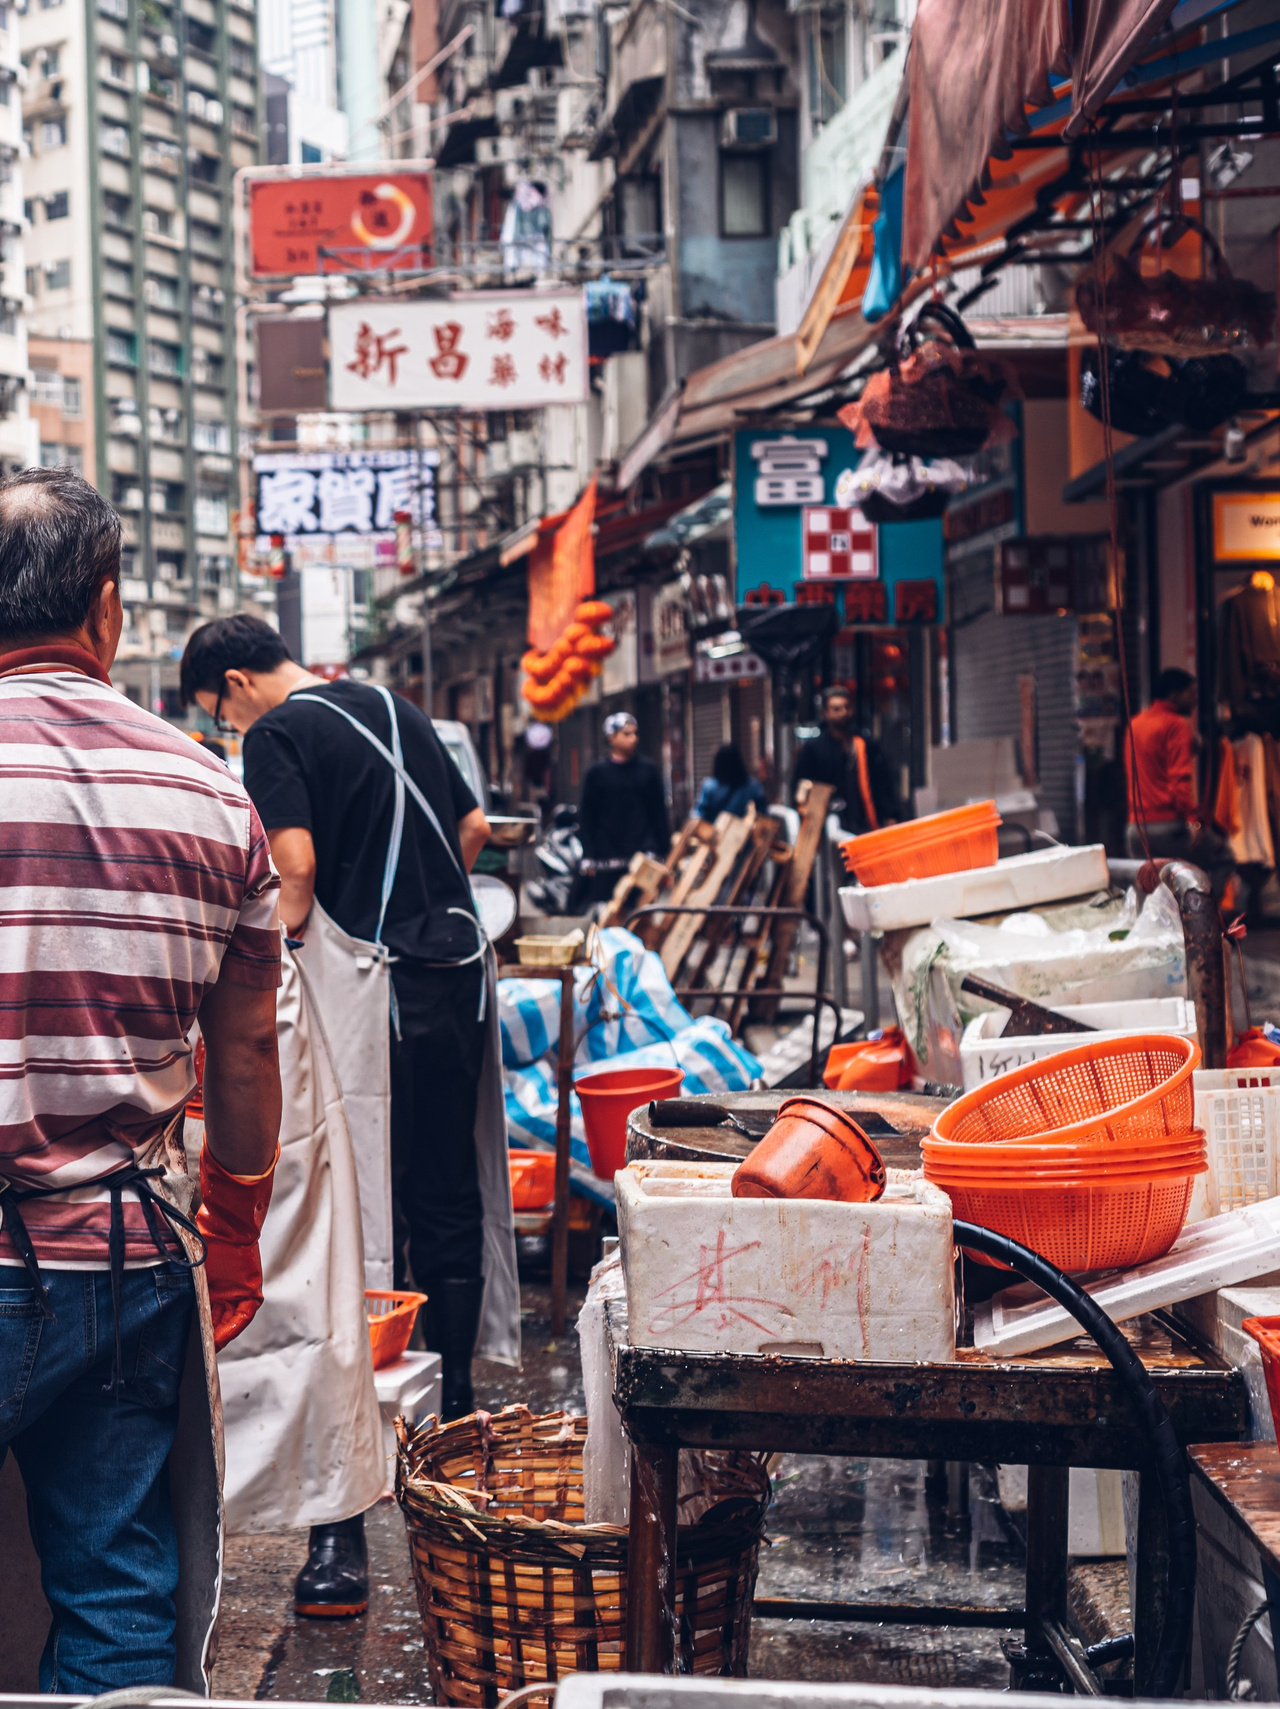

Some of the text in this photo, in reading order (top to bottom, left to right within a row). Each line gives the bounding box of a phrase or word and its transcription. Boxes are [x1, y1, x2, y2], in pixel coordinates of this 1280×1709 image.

[485, 306, 570, 343] 海味
[345, 320, 470, 387] 新昌
[487, 350, 569, 390] 藥材
[750, 434, 828, 505] 富
